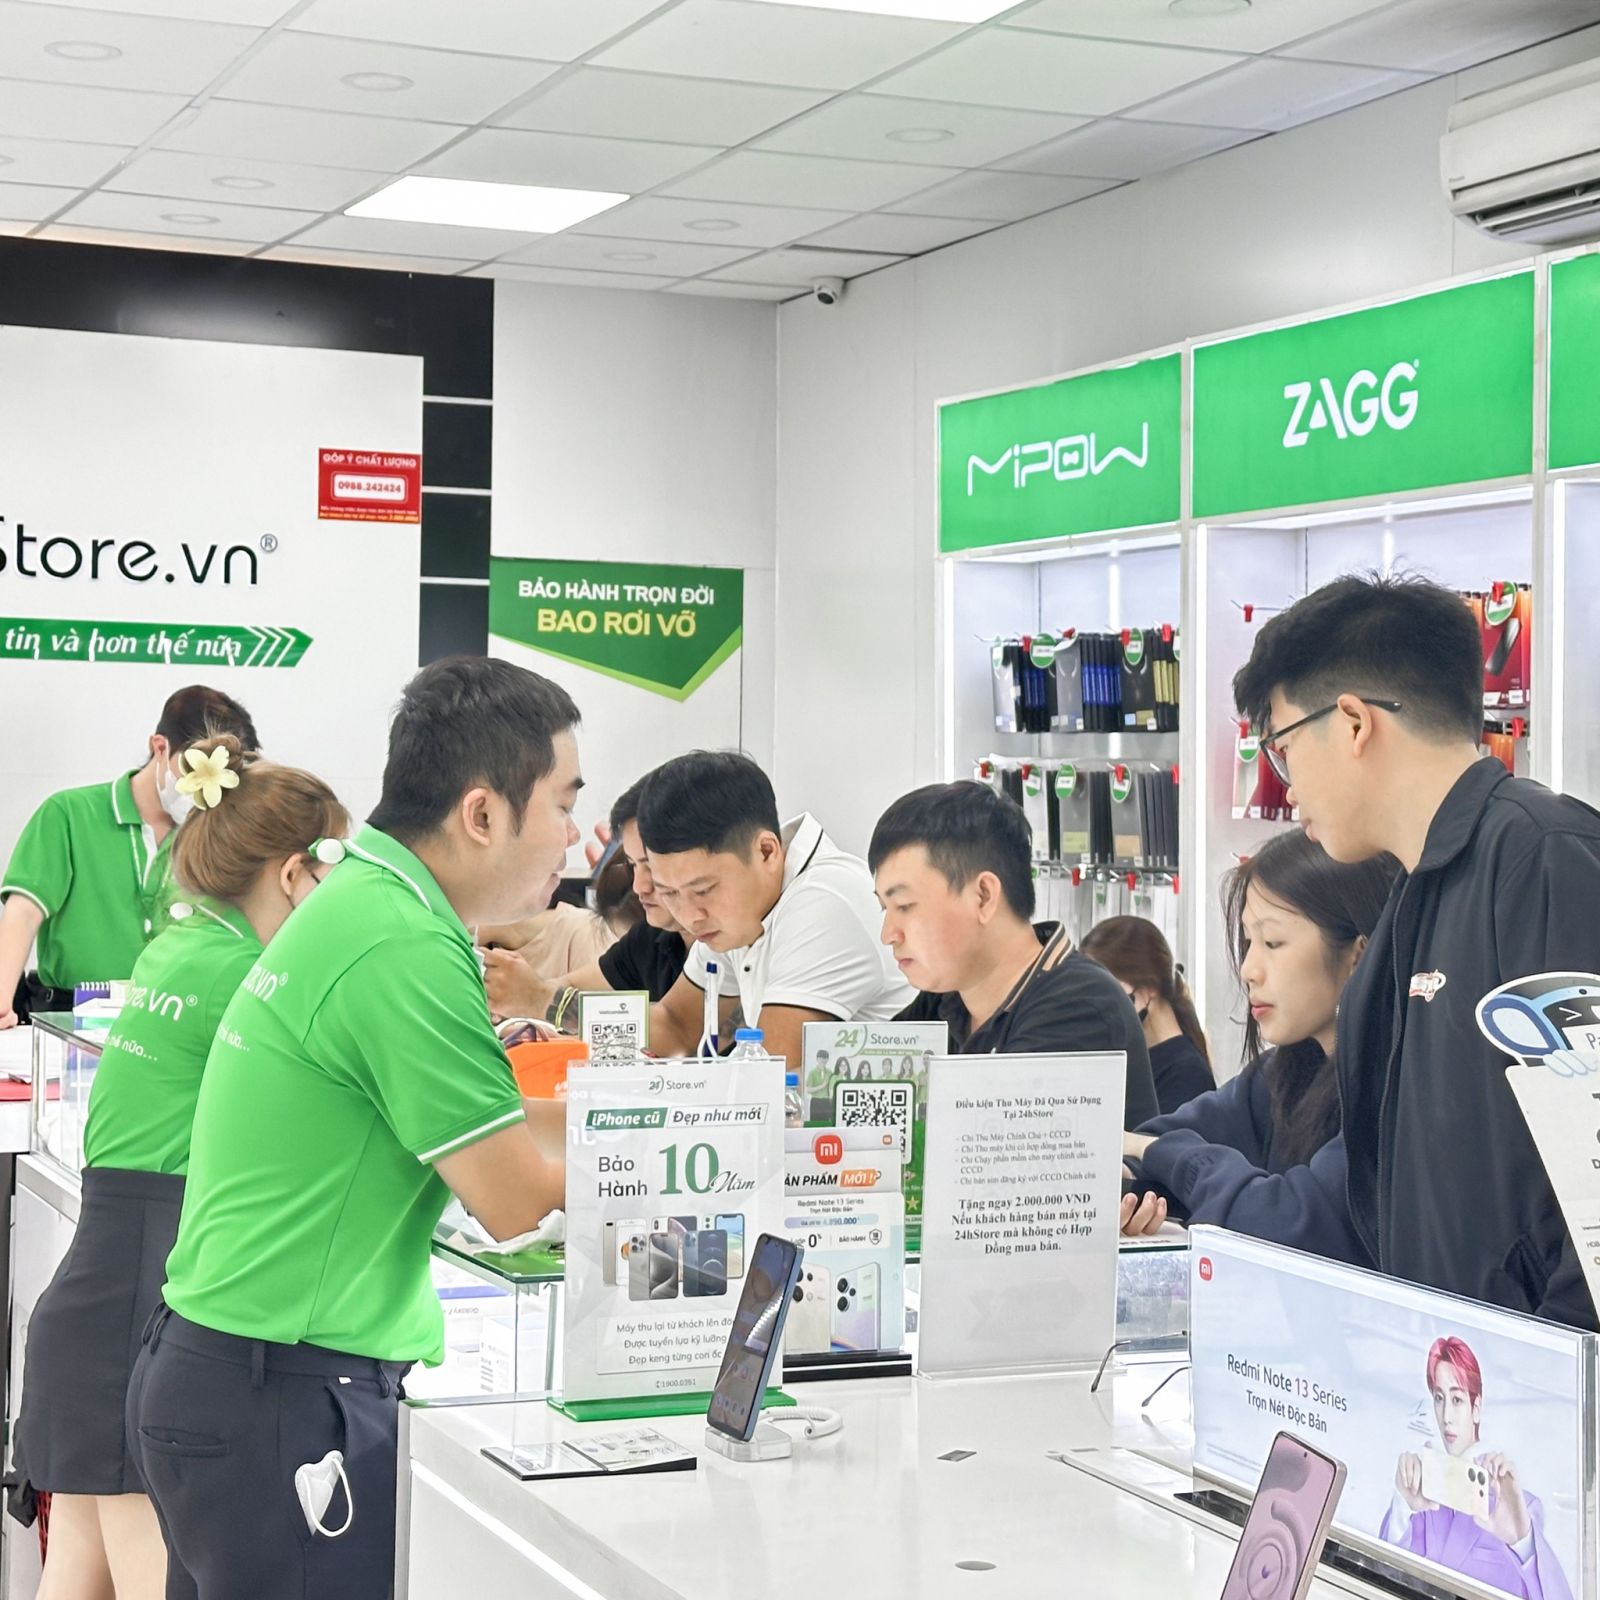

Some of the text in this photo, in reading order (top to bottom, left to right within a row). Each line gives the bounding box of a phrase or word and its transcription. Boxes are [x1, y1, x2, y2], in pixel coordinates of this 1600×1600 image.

[1282, 361, 1418, 448] ZAGG
[338, 481, 401, 492] 0988.242424
[518, 576, 715, 606] BẢO HÀNH TRỌN ĐỜI
[537, 608, 697, 638] BAO RƠI VỠ
[51, 627, 81, 653] và
[88, 627, 138, 657] hơn
[146, 628, 196, 658] thế
[1048, 1097, 1064, 1106] Qua
[591, 1107, 762, 1126] iPhone cũ Đẹp như mới
[1018, 1110, 1054, 1118] 24hStore
[598, 1154, 635, 1172] Bảo
[658, 1142, 721, 1195] 10
[960, 1166, 983, 1174] CCCD
[598, 1179, 648, 1198] Hành
[988, 1200, 1012, 1210] ngay
[1015, 1196, 1063, 1206] 2.000.000
[952, 1208, 1096, 1226] Nếu khách hàng bán máy tại
[954, 1224, 1092, 1241] 24hStore mà không có Hợp
[984, 1241, 1062, 1255] Đồng mua bán.
[616, 1323, 636, 1334] Máy
[638, 1323, 652, 1332] thu
[654, 1322, 664, 1332] lại
[668, 1320, 676, 1330] từ
[678, 1320, 704, 1328] khách
[706, 1318, 719, 1328] lên
[624, 1339, 647, 1350] Được
[649, 1336, 674, 1348] tuyển
[692, 1335, 700, 1346] kỹ
[629, 1355, 647, 1366] Đẹp
[649, 1354, 670, 1364] keng
[672, 1354, 692, 1362] từng
[694, 1352, 710, 1360] con
[1227, 1353, 1347, 1412] Redmi Note 13 Series
[1246, 1389, 1327, 1433] Trọn Nét Độc Bản
